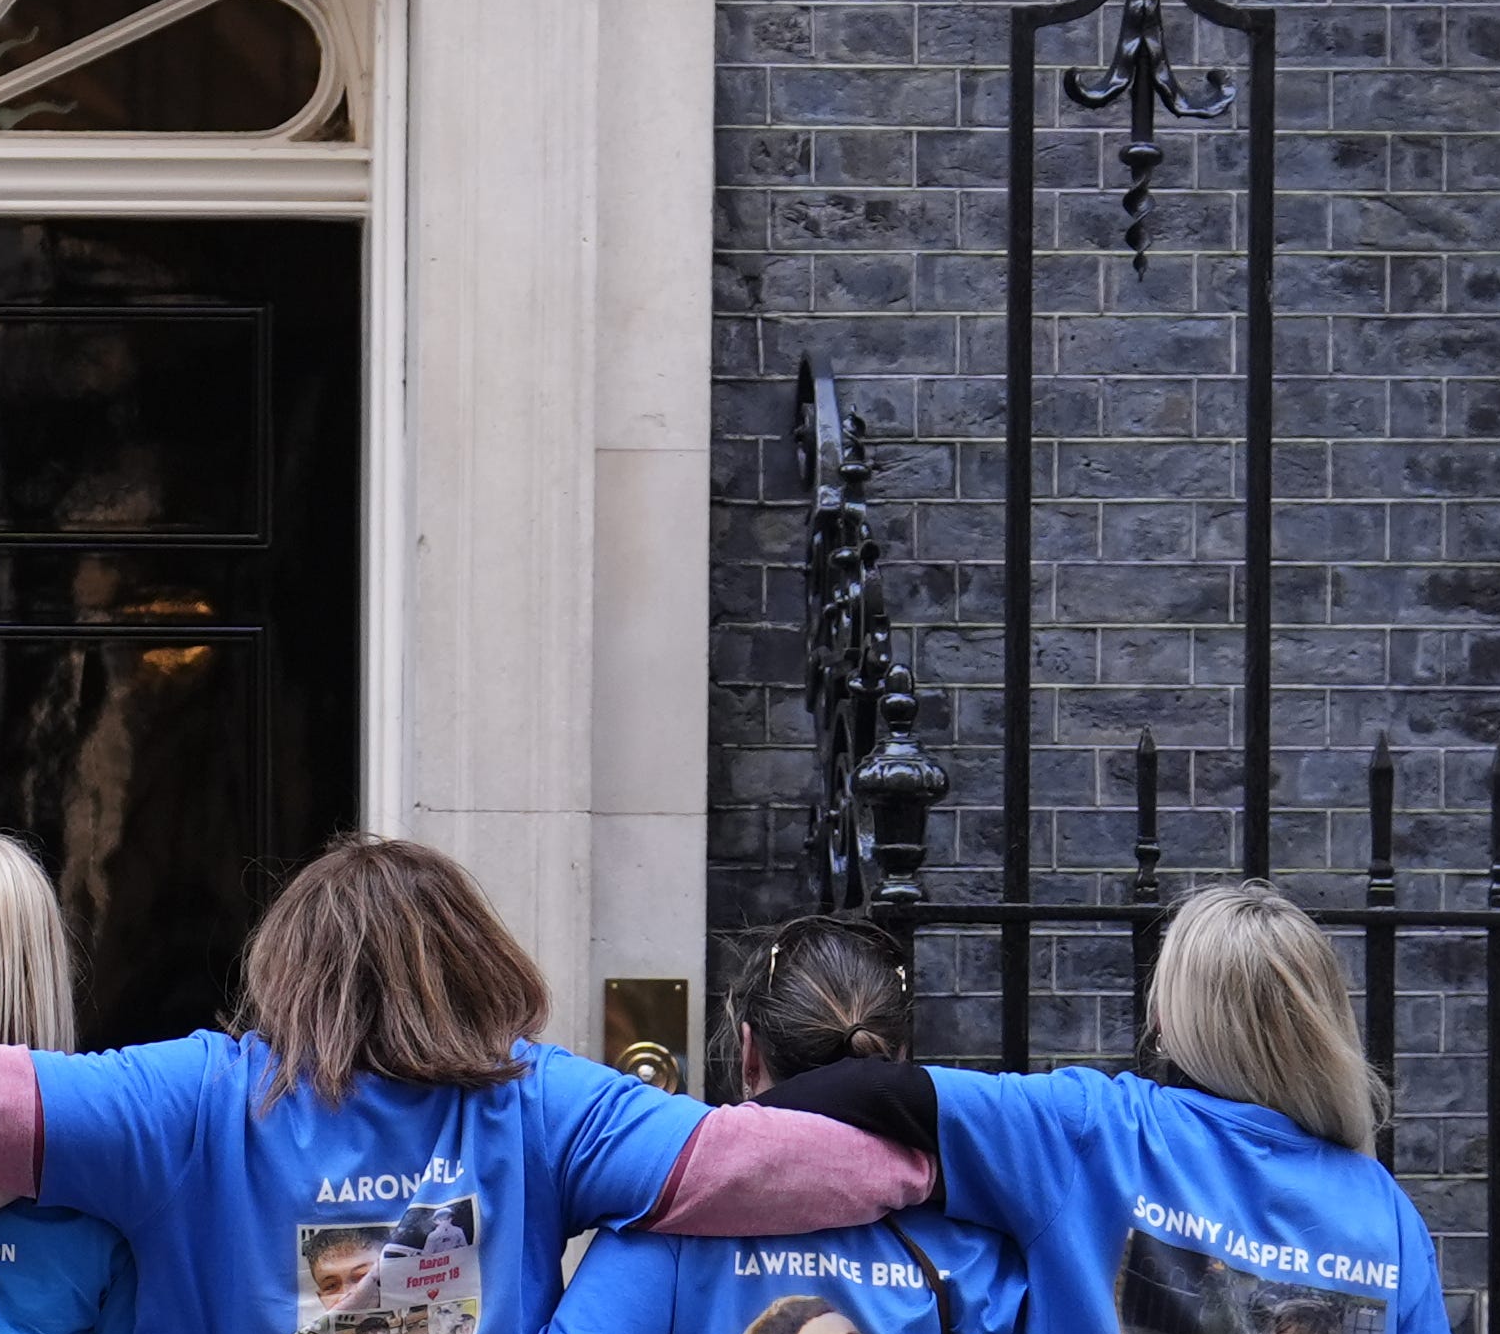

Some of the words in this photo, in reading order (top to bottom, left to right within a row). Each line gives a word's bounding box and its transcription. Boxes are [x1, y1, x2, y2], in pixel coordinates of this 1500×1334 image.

[316, 1173, 421, 1203] AARON
[1133, 1195, 1223, 1244] SONNY
[1225, 1230, 1309, 1273] JASPER
[1317, 1253, 1399, 1289] CRANE
[406, 1271, 447, 1289] Forever
[449, 1266, 460, 1280] 18
[734, 1251, 862, 1284] LAWRENCE
[871, 1262, 951, 1288] BRU
